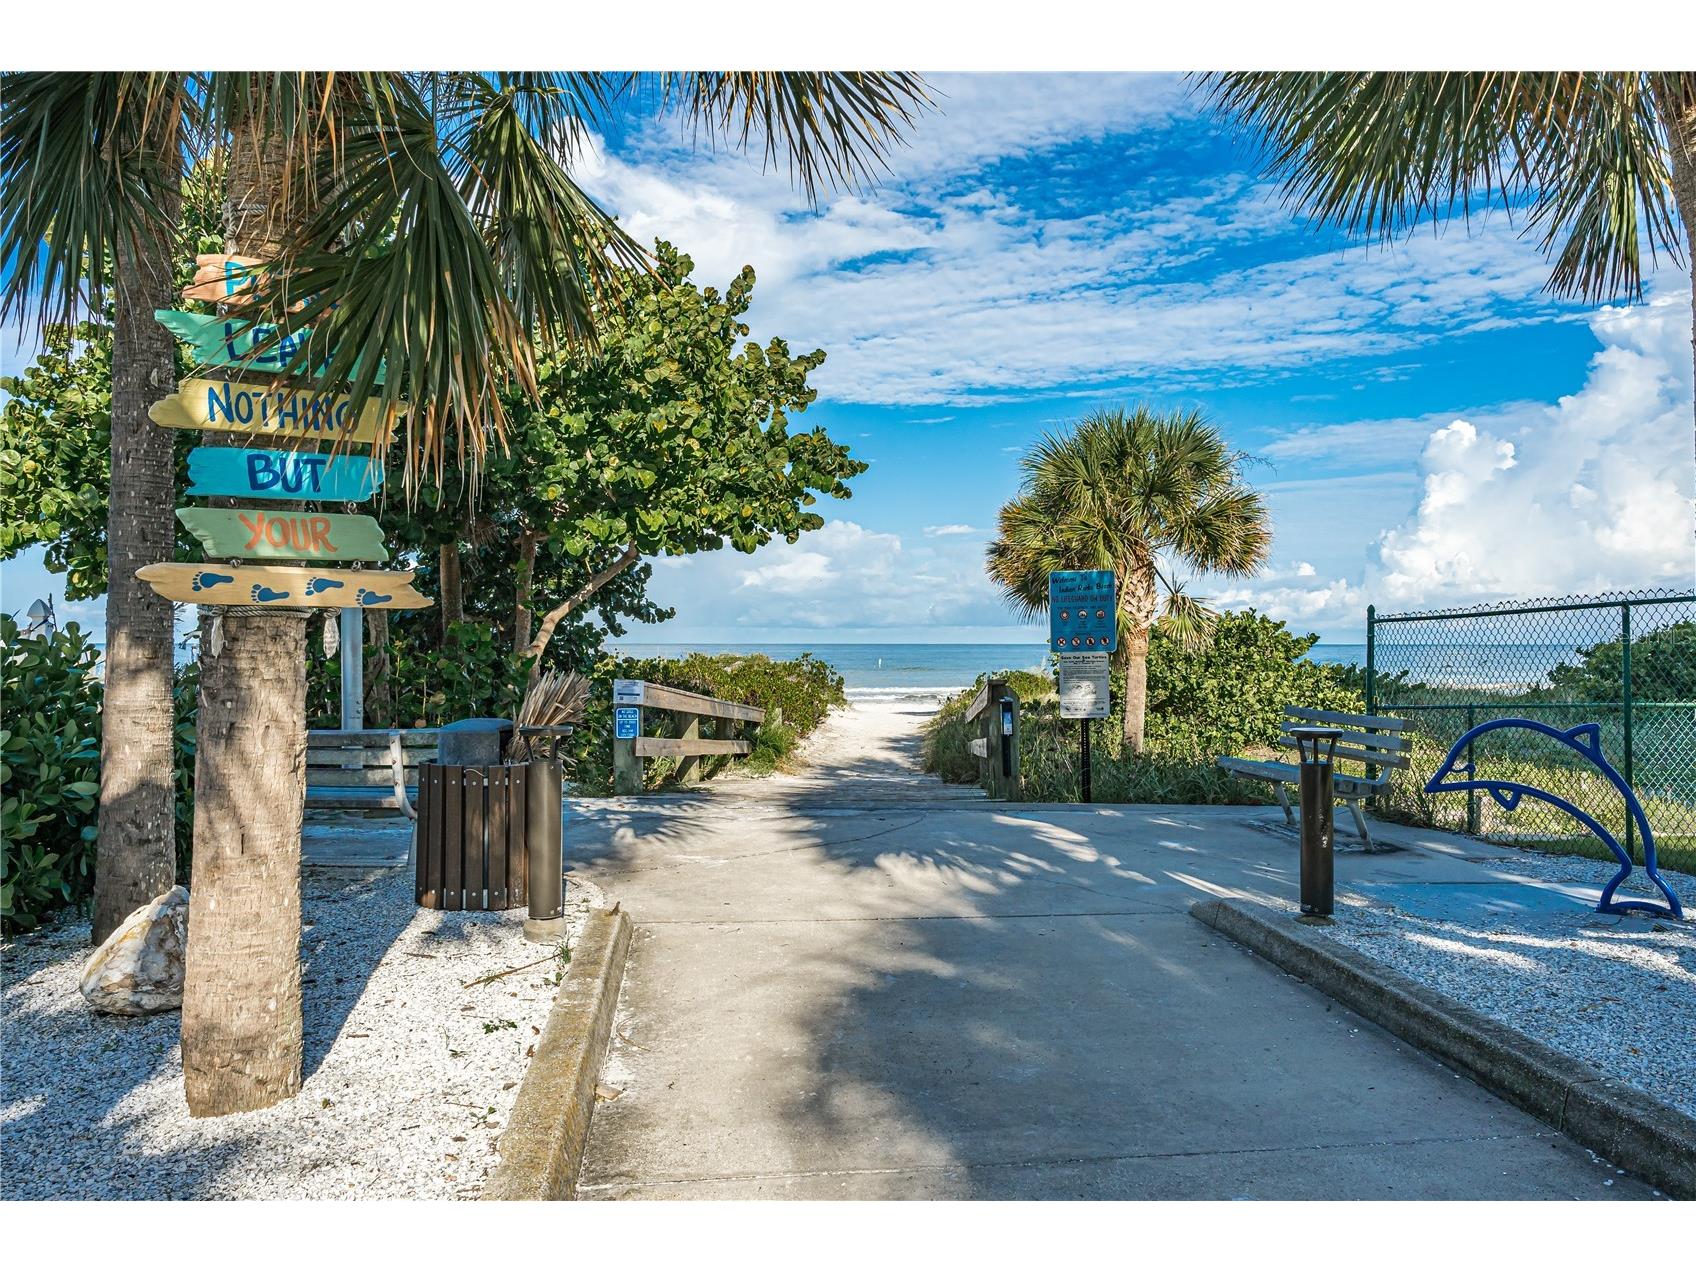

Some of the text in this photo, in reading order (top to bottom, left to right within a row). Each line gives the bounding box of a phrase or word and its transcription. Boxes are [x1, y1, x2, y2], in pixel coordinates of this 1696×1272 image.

[225, 322, 338, 371] LEA
[246, 453, 327, 493] BUT
[238, 511, 341, 552] YOUR
